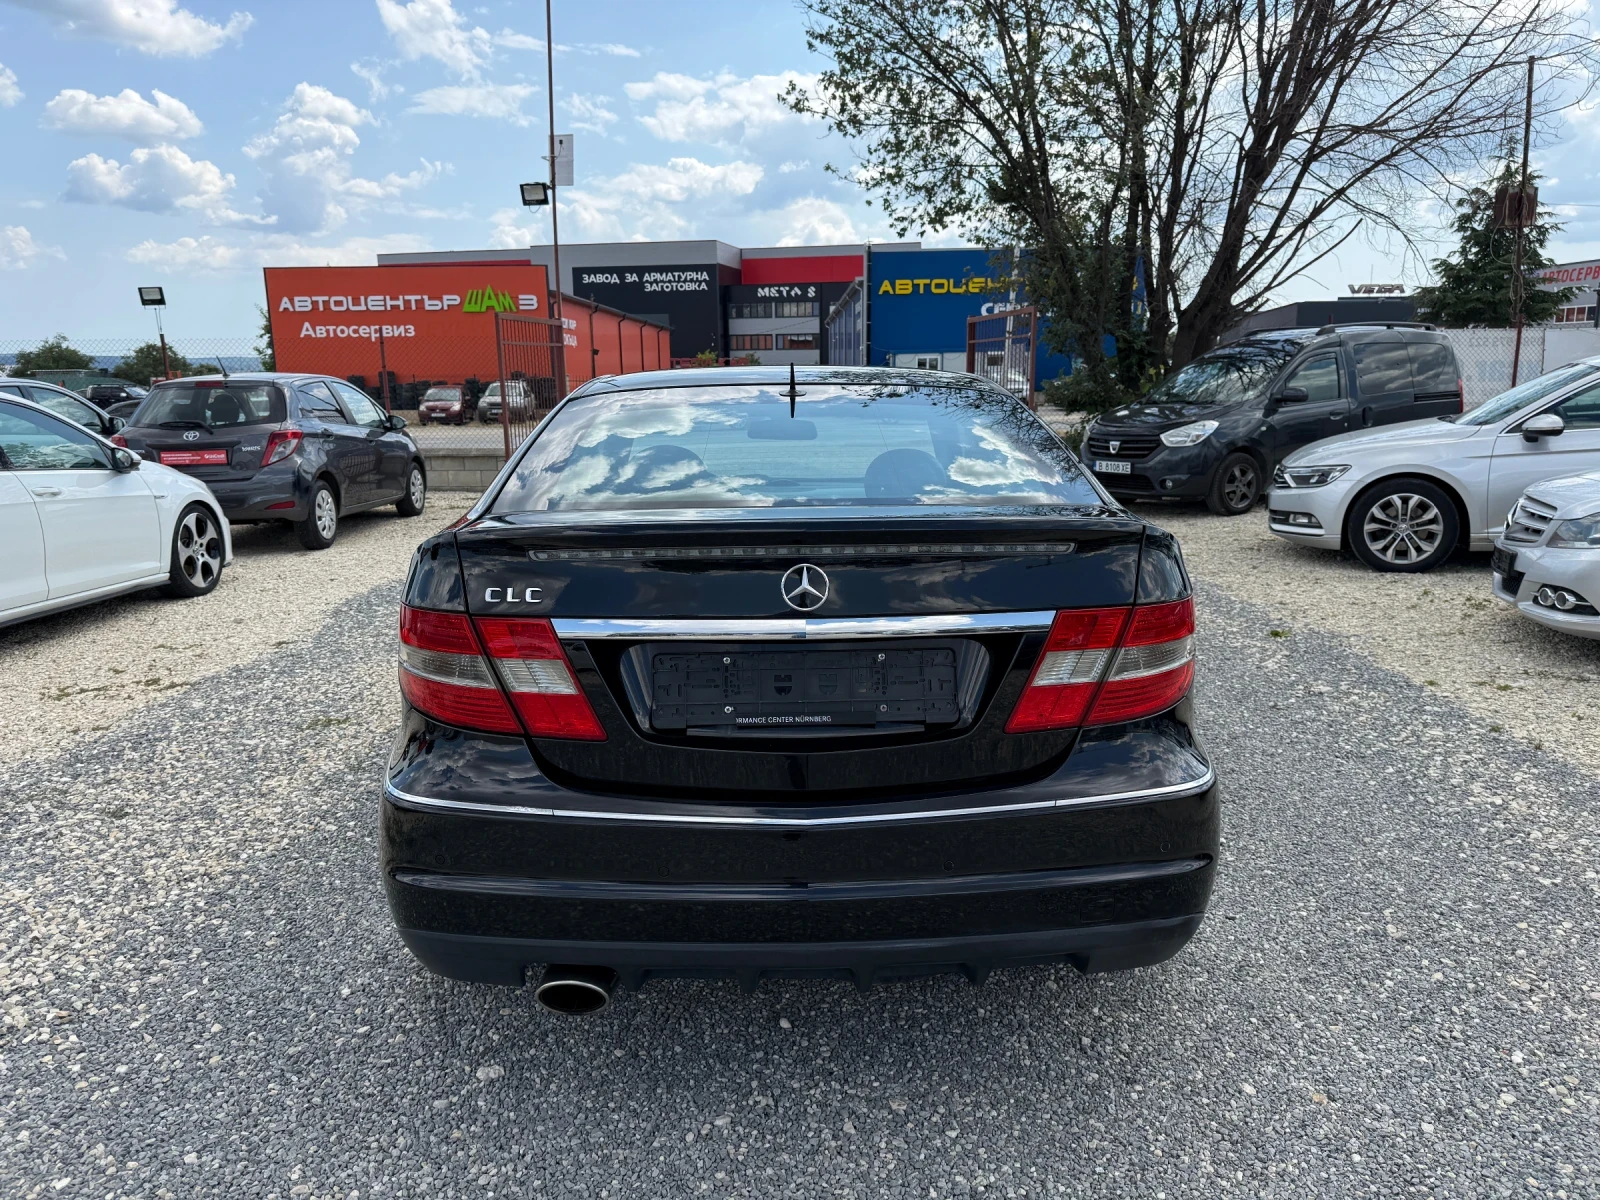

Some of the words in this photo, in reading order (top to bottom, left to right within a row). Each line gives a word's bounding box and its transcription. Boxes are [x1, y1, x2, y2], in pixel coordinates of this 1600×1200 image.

[582, 274, 620, 284] ЗАВОД
[624, 273, 639, 283] ЗА
[643, 271, 709, 282] АРМАТУРНА
[644, 282, 708, 292] ЗАГОТОВКА
[1348, 284, 1406, 294] VEGA
[279, 294, 461, 312] АВТОЦЕНТЪР
[462, 284, 517, 312] ШАМ
[300, 321, 416, 342] Автосервиз
[485, 587, 543, 603] CLC
[795, 715, 832, 723] NÜRNBERG
